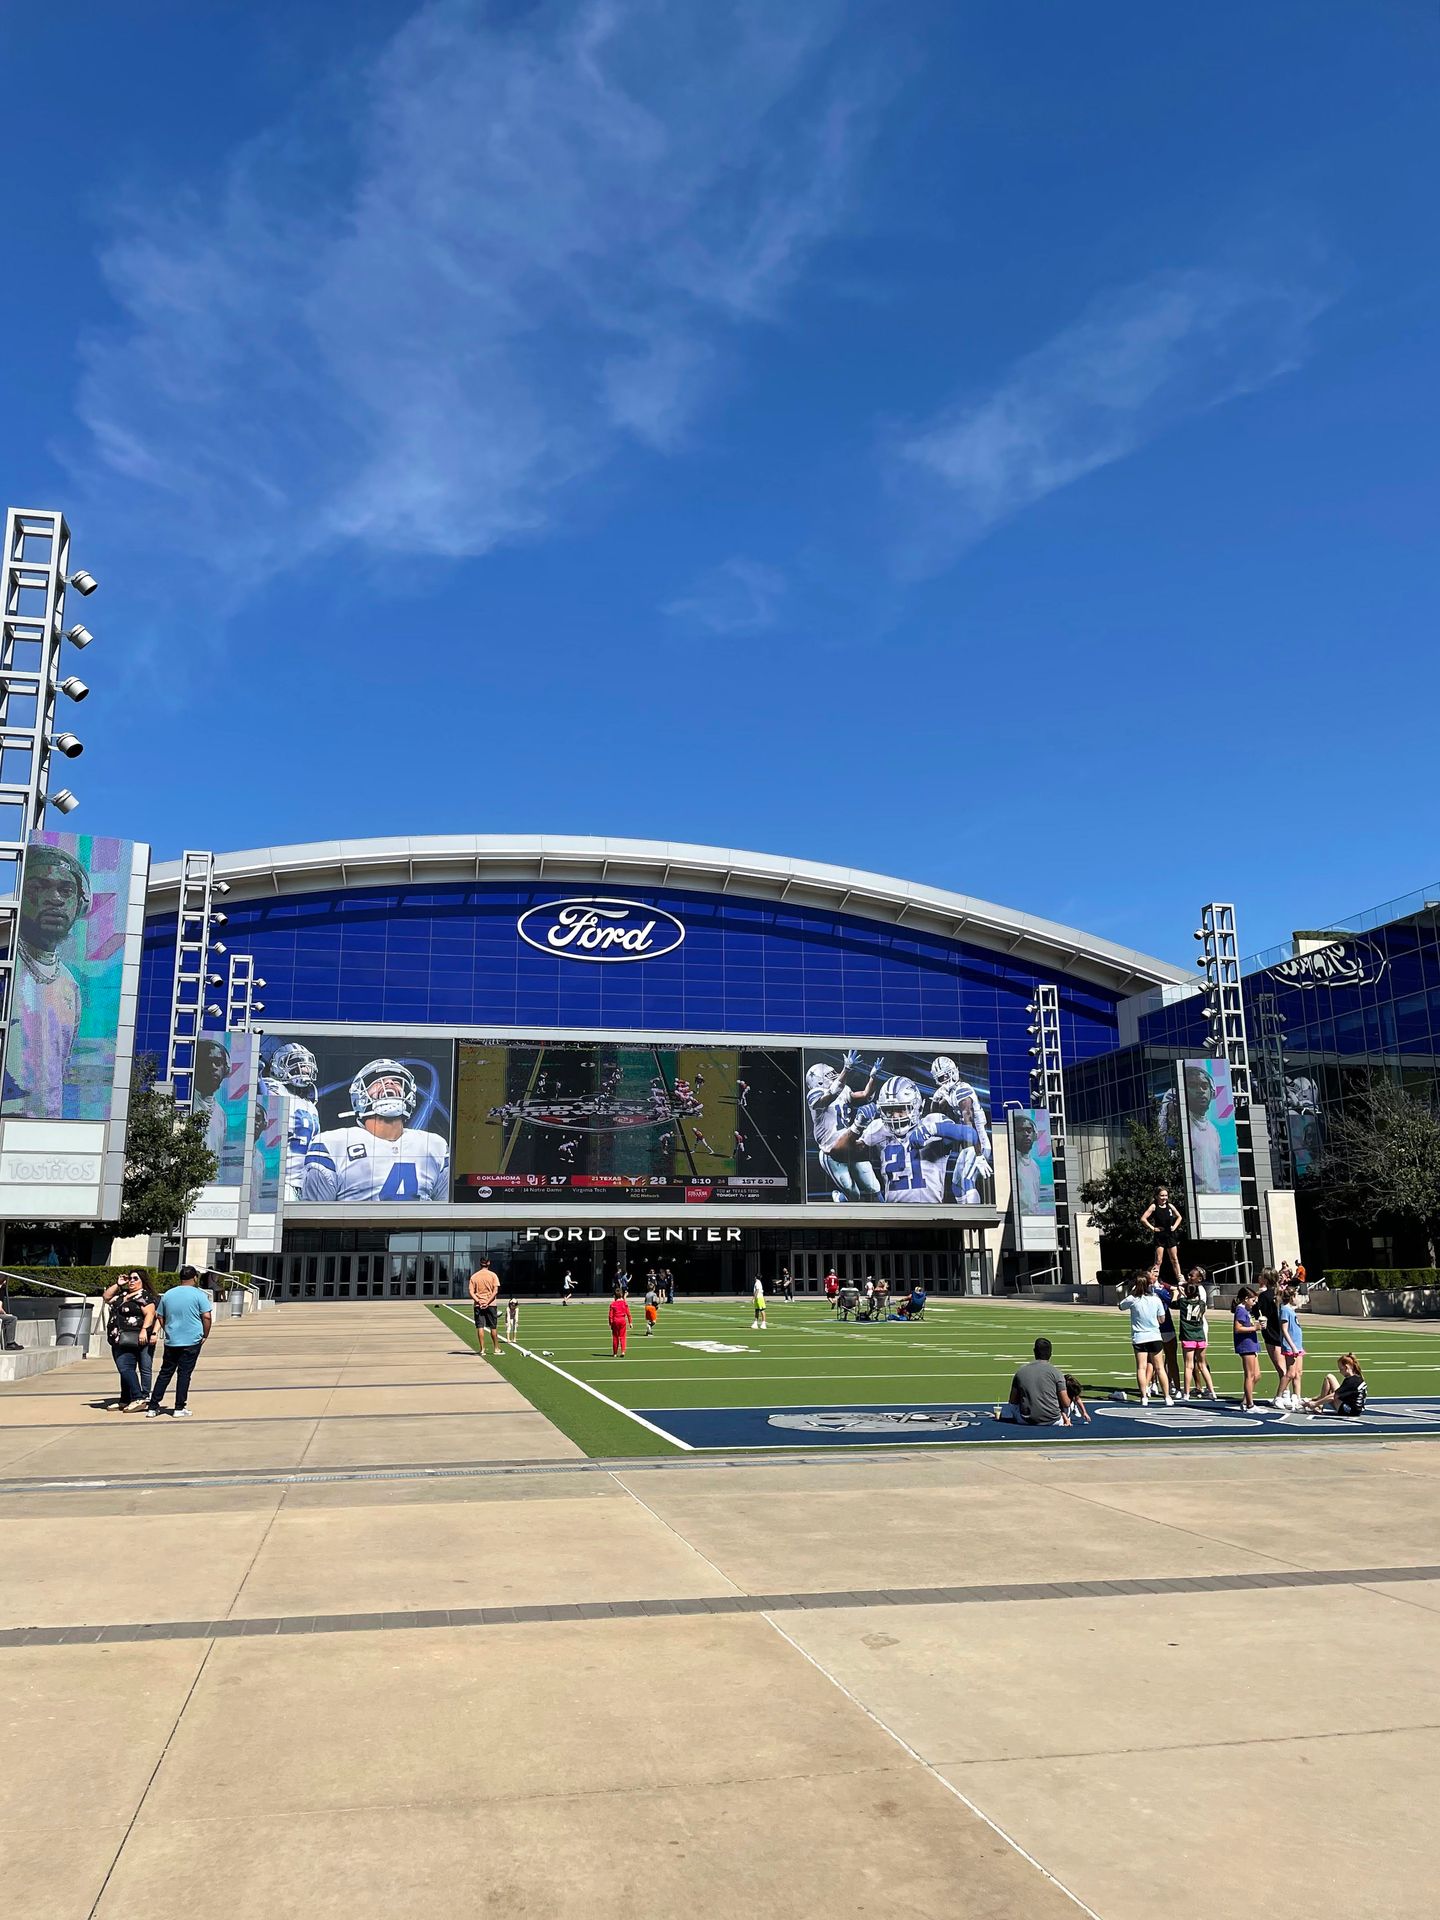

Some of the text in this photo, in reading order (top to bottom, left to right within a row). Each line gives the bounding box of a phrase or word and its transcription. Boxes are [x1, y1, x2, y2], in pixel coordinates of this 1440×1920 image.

[547, 905, 657, 952] Ford
[352, 1144, 365, 1156] C
[884, 1144, 927, 1191] 21
[379, 1162, 419, 1201] 4
[550, 1176, 567, 1185] 17
[649, 1176, 667, 1185] 28
[525, 1226, 742, 1242] FORD CENTER
[1185, 1303, 1203, 1322] 14
